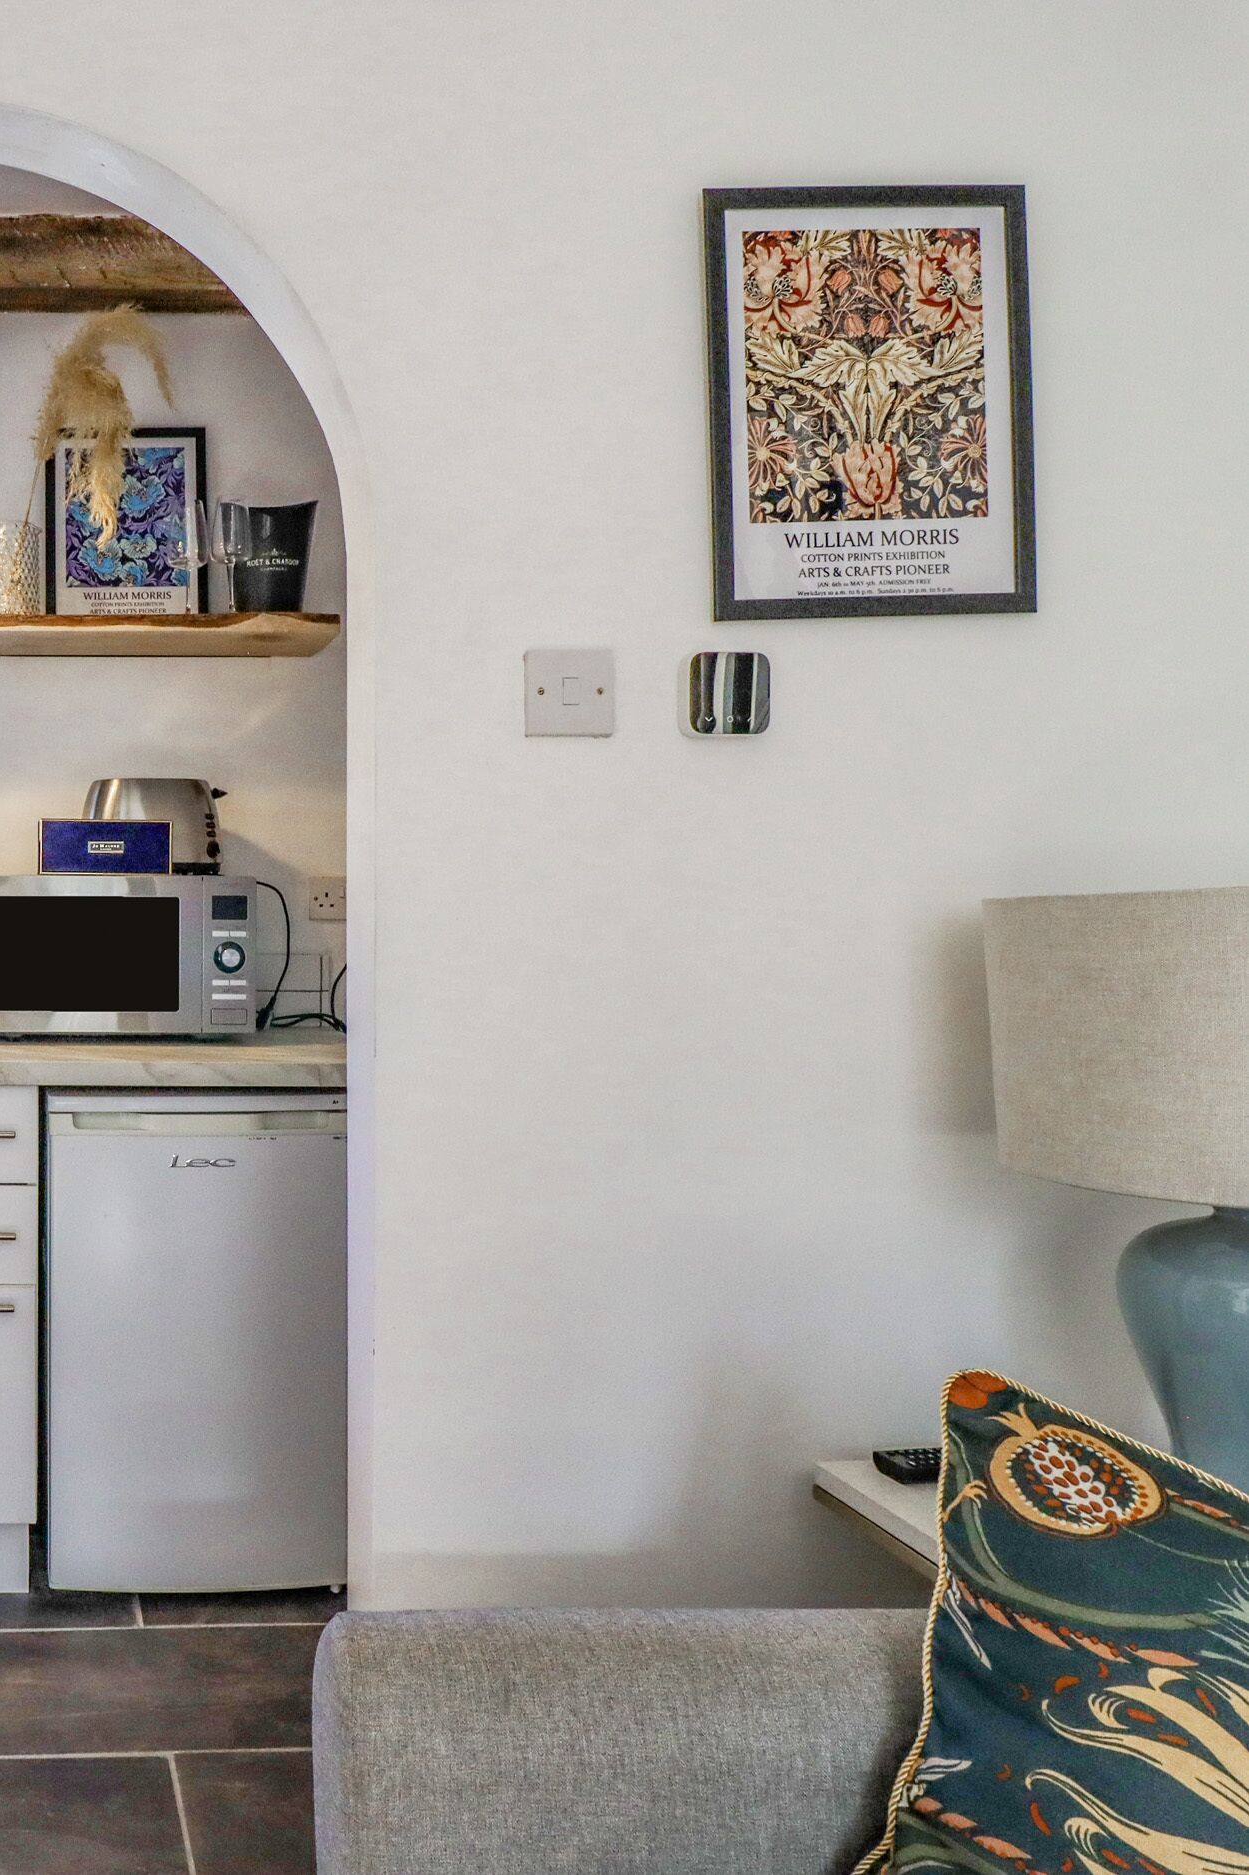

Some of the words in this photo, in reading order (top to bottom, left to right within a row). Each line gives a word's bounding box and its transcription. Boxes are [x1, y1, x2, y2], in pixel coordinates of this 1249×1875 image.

[784, 531, 873, 549] WILLIAM
[881, 528, 960, 546] MORRIS
[801, 553, 845, 563] COTTON
[847, 551, 883, 562] PRINTS
[886, 550, 946, 561] EXHIBITION
[798, 567, 830, 578] ARTS
[833, 566, 843, 578] &
[845, 565, 892, 577] CRAFTS
[895, 564, 950, 575] PIONEER
[83, 592, 129, 601] WILLIAM
[131, 591, 172, 600] MORRIS
